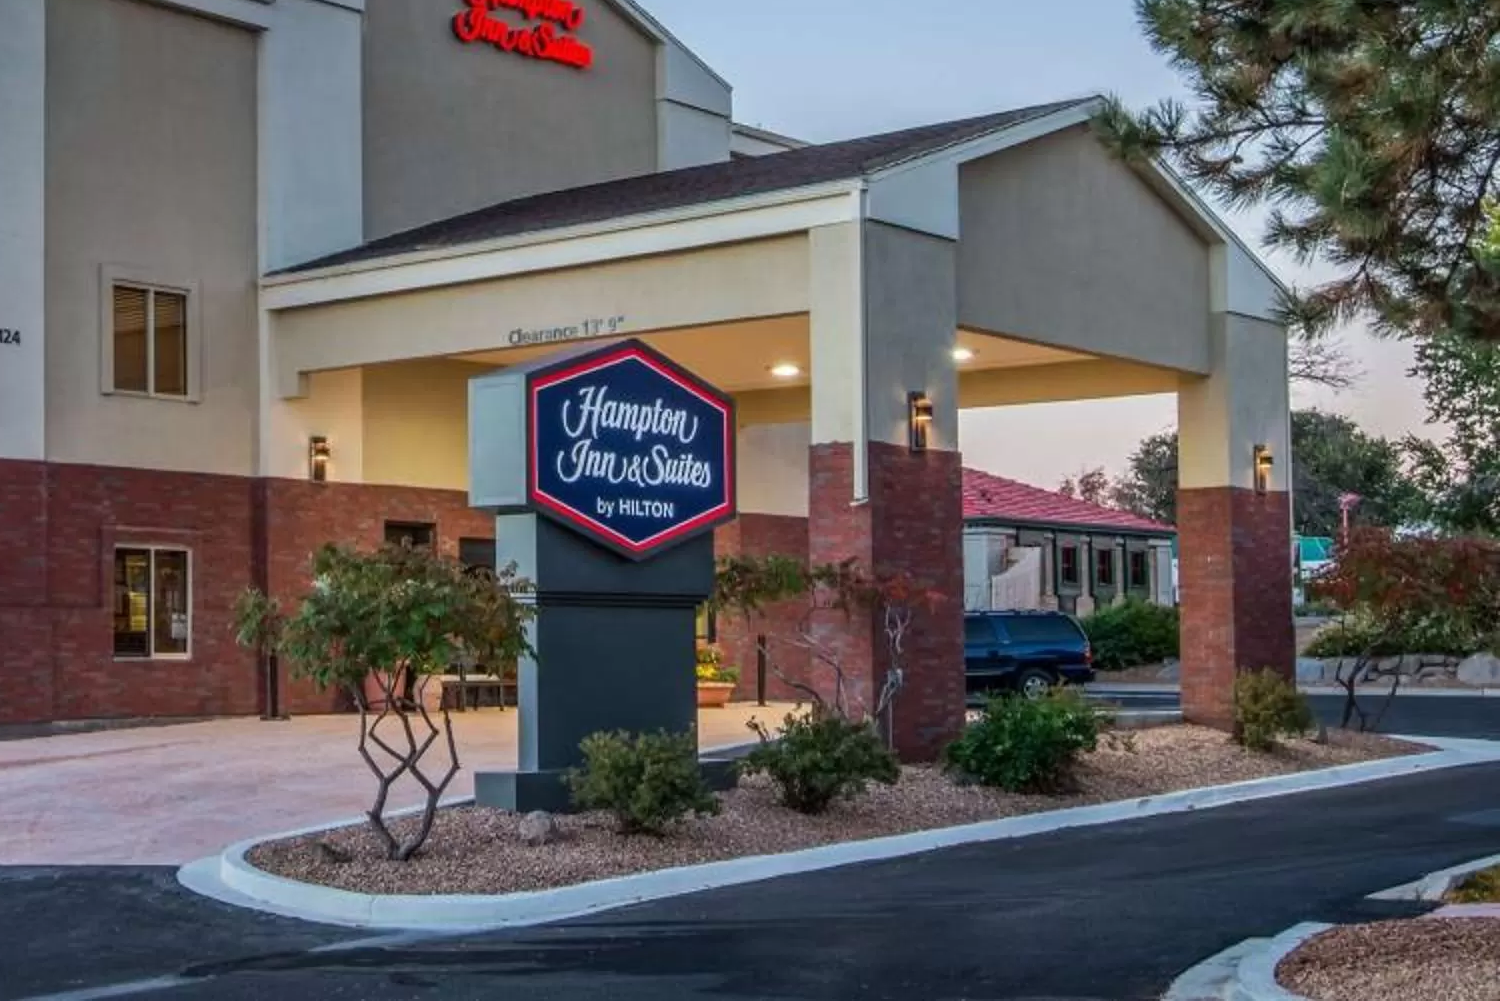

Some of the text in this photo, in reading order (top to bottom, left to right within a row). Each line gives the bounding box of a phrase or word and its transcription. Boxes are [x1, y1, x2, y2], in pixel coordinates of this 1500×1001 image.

[508, 326, 579, 345] Clearance
[562, 385, 699, 444] Hampton
[556, 439, 627, 484] Inn
[642, 444, 712, 488] Suites
[596, 497, 675, 519] by HILTON
